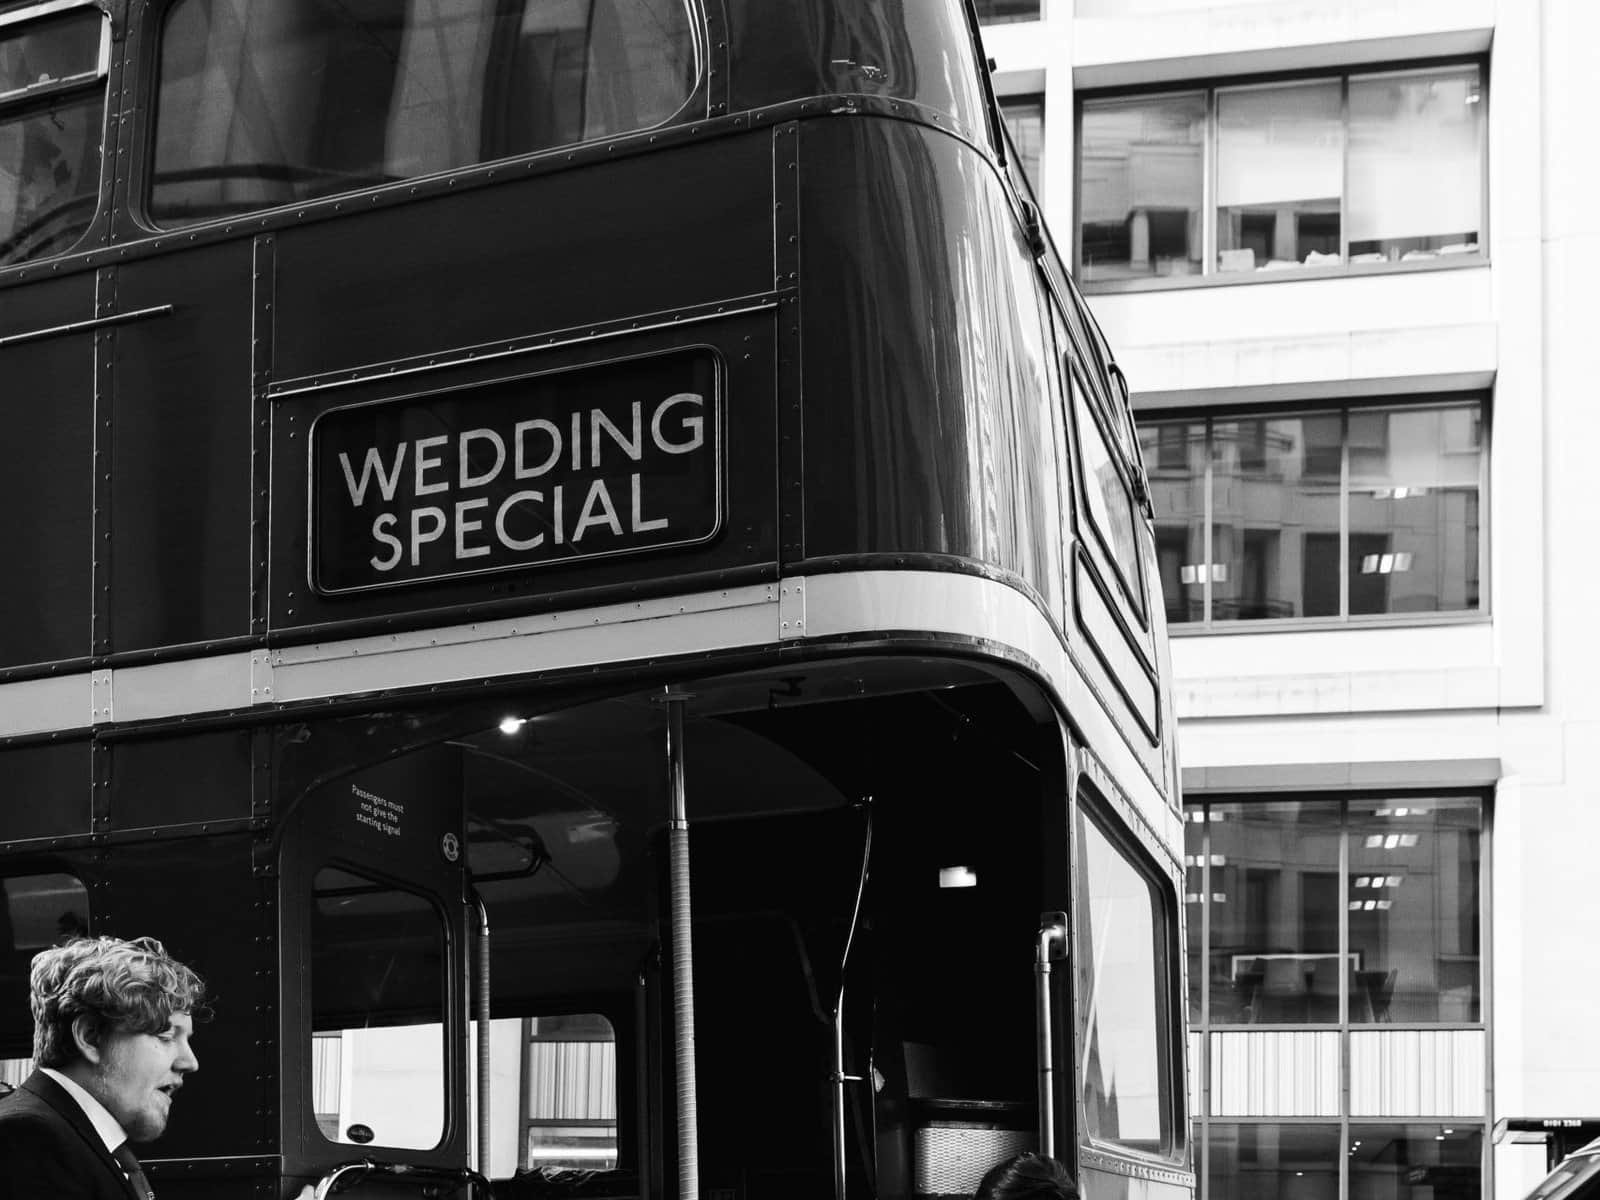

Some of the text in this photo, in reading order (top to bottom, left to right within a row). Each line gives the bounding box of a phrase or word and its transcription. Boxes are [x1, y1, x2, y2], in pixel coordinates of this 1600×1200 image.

[338, 392, 704, 507] WEDDING
[369, 472, 669, 572] SPECIAL
[351, 783, 404, 814] Passengers must
[360, 802, 398, 823] not give the
[356, 813, 401, 836] starting signal
